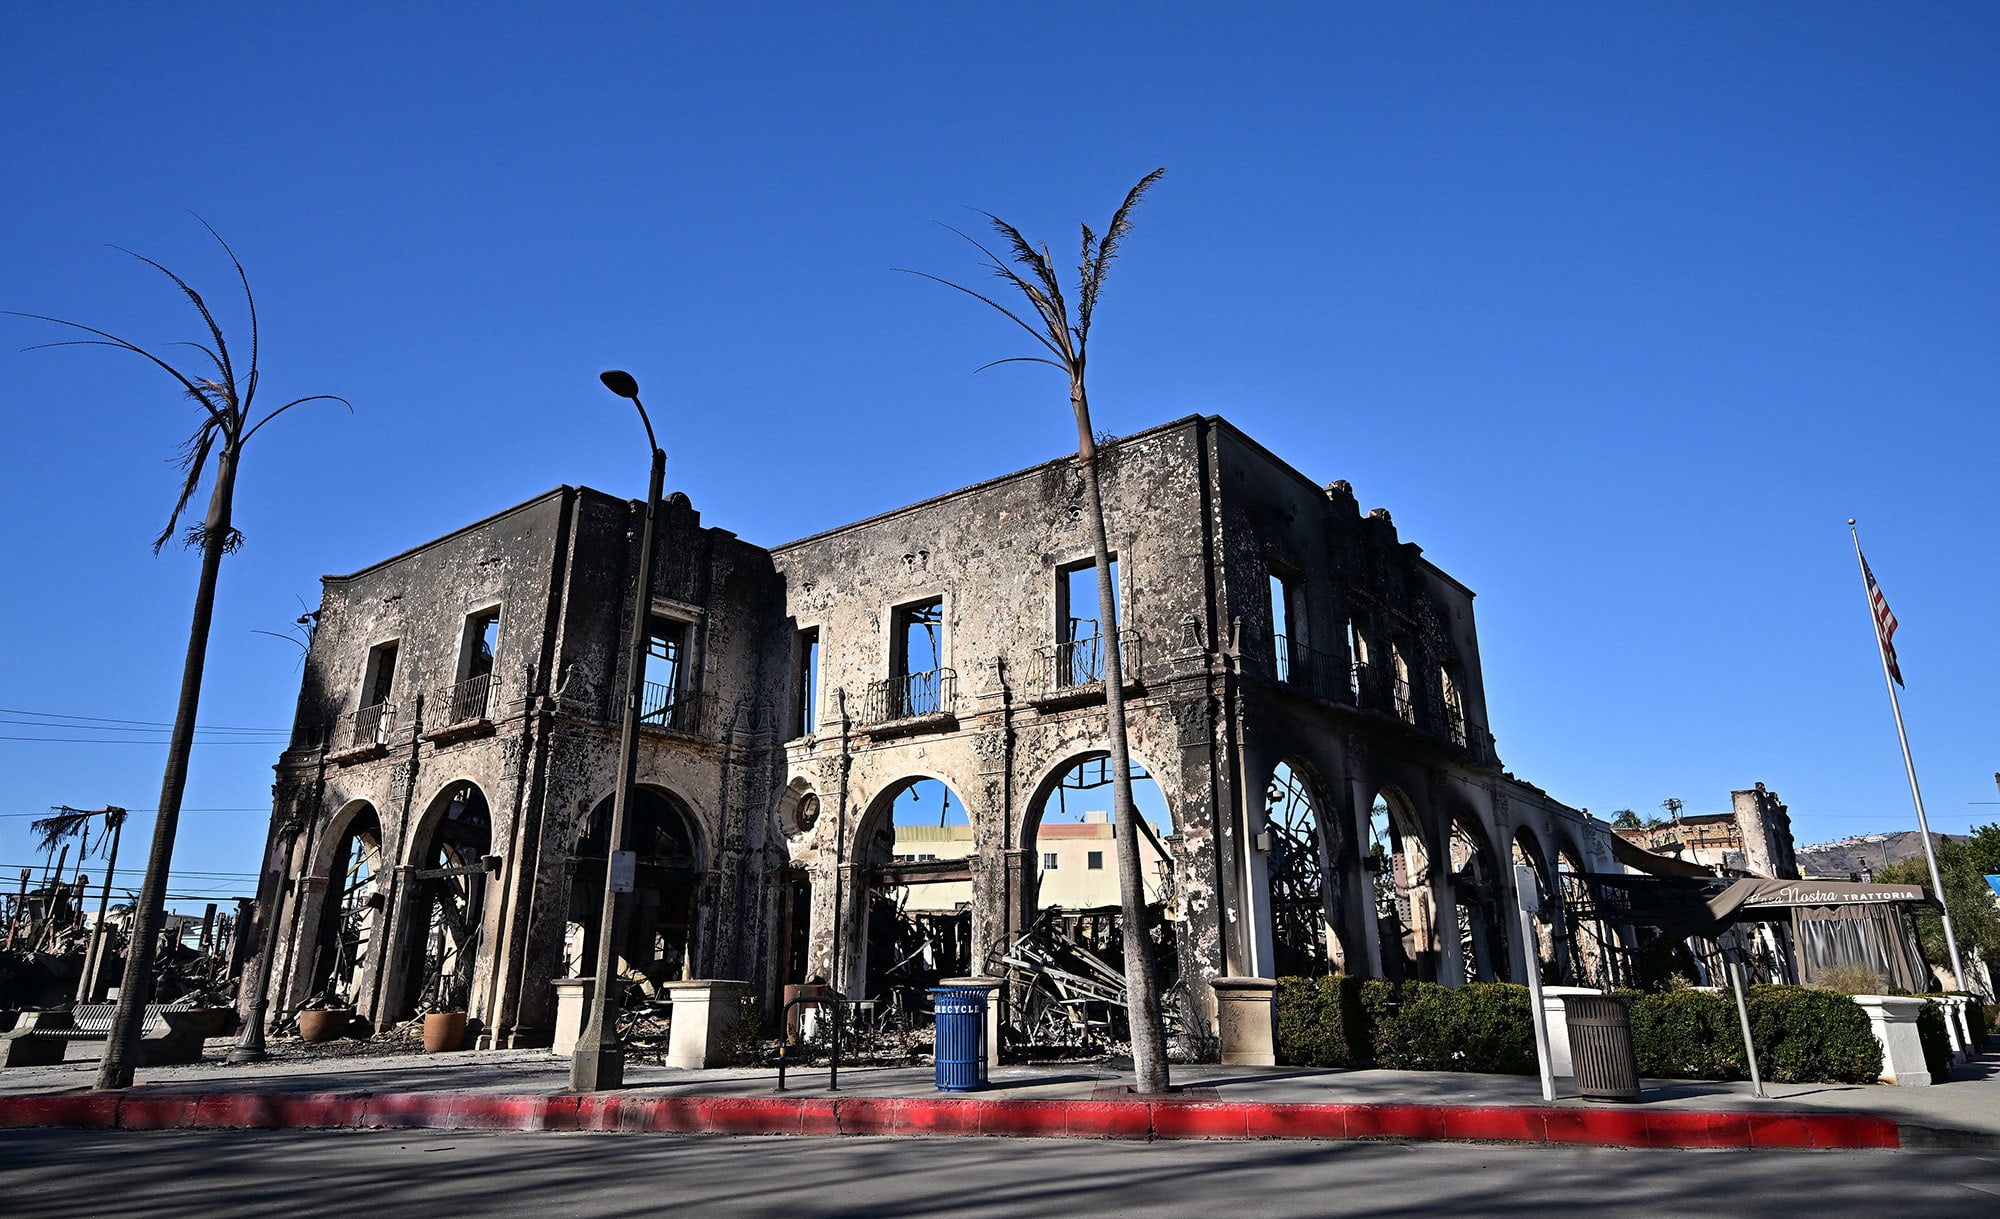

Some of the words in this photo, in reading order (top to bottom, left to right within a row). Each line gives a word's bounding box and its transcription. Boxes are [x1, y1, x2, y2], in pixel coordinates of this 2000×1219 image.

[1780, 887, 1838, 903] Nostra
[1843, 891, 1914, 901] TRATTORIA
[935, 1005, 980, 1014] RECYCLE
